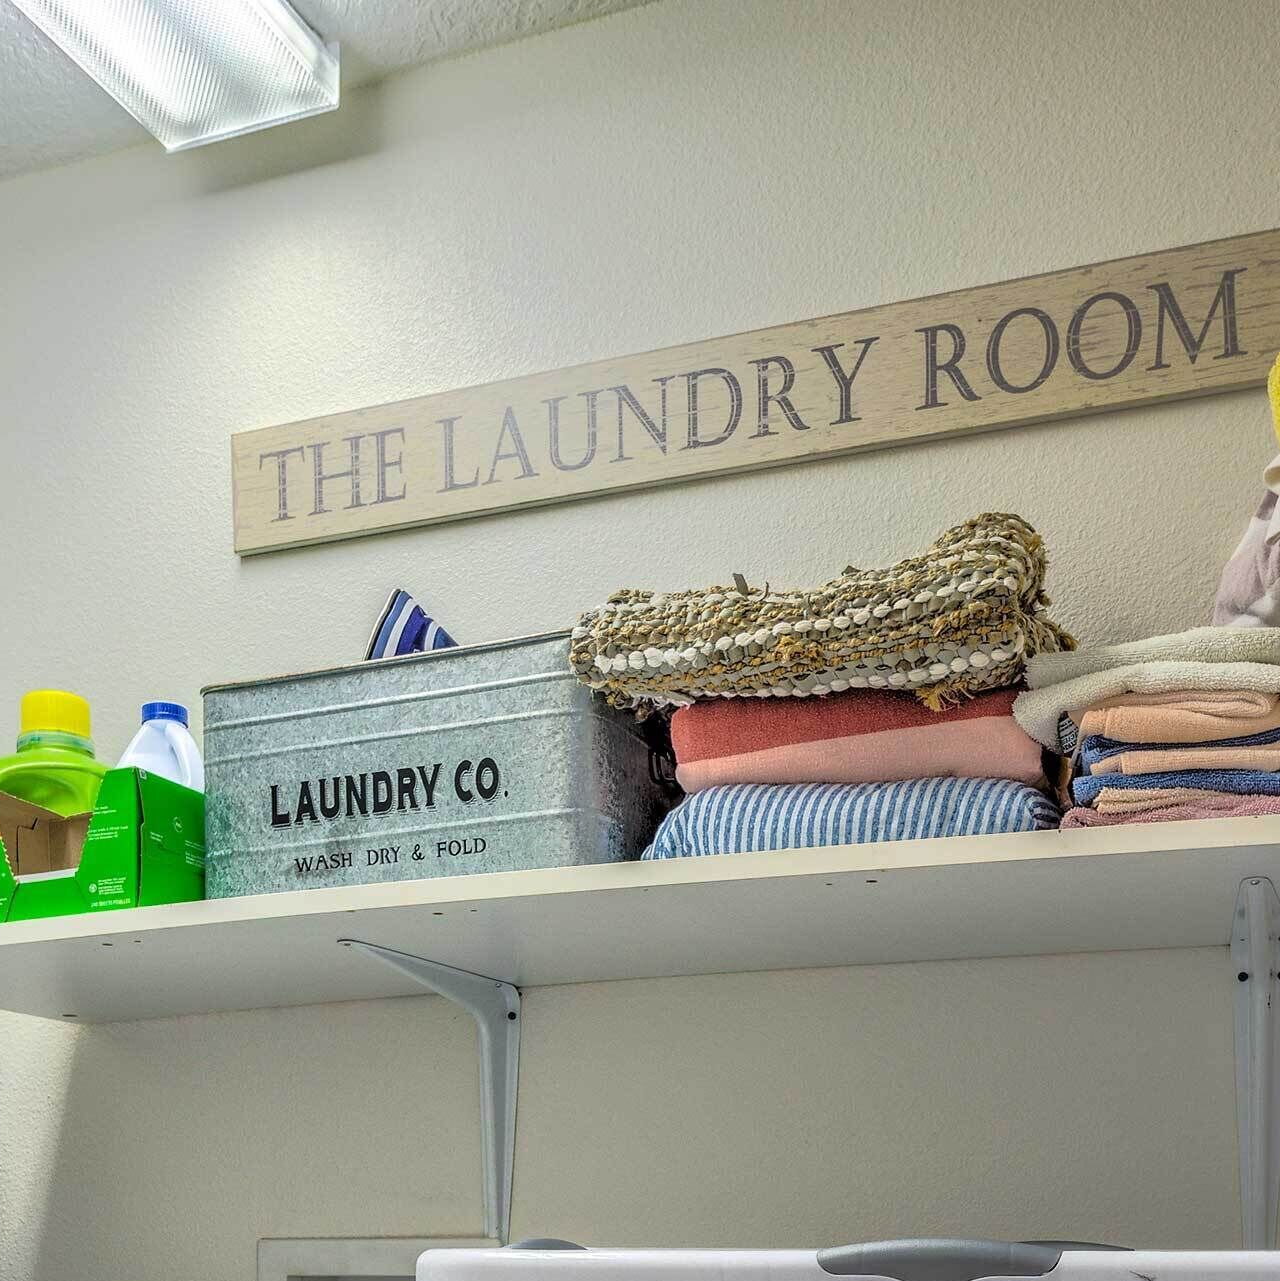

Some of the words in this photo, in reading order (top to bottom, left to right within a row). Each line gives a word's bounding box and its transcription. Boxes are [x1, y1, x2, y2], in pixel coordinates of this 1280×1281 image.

[259, 428, 407, 523] THE
[436, 336, 880, 495] LAUNDRY
[915, 267, 1245, 410] ROOM
[269, 762, 442, 829] LAUNDRY
[454, 758, 509, 803] CO.
[294, 851, 353, 873] WASH
[366, 848, 401, 864] DRY
[411, 845, 424, 861] &
[436, 838, 486, 858] FOLD
